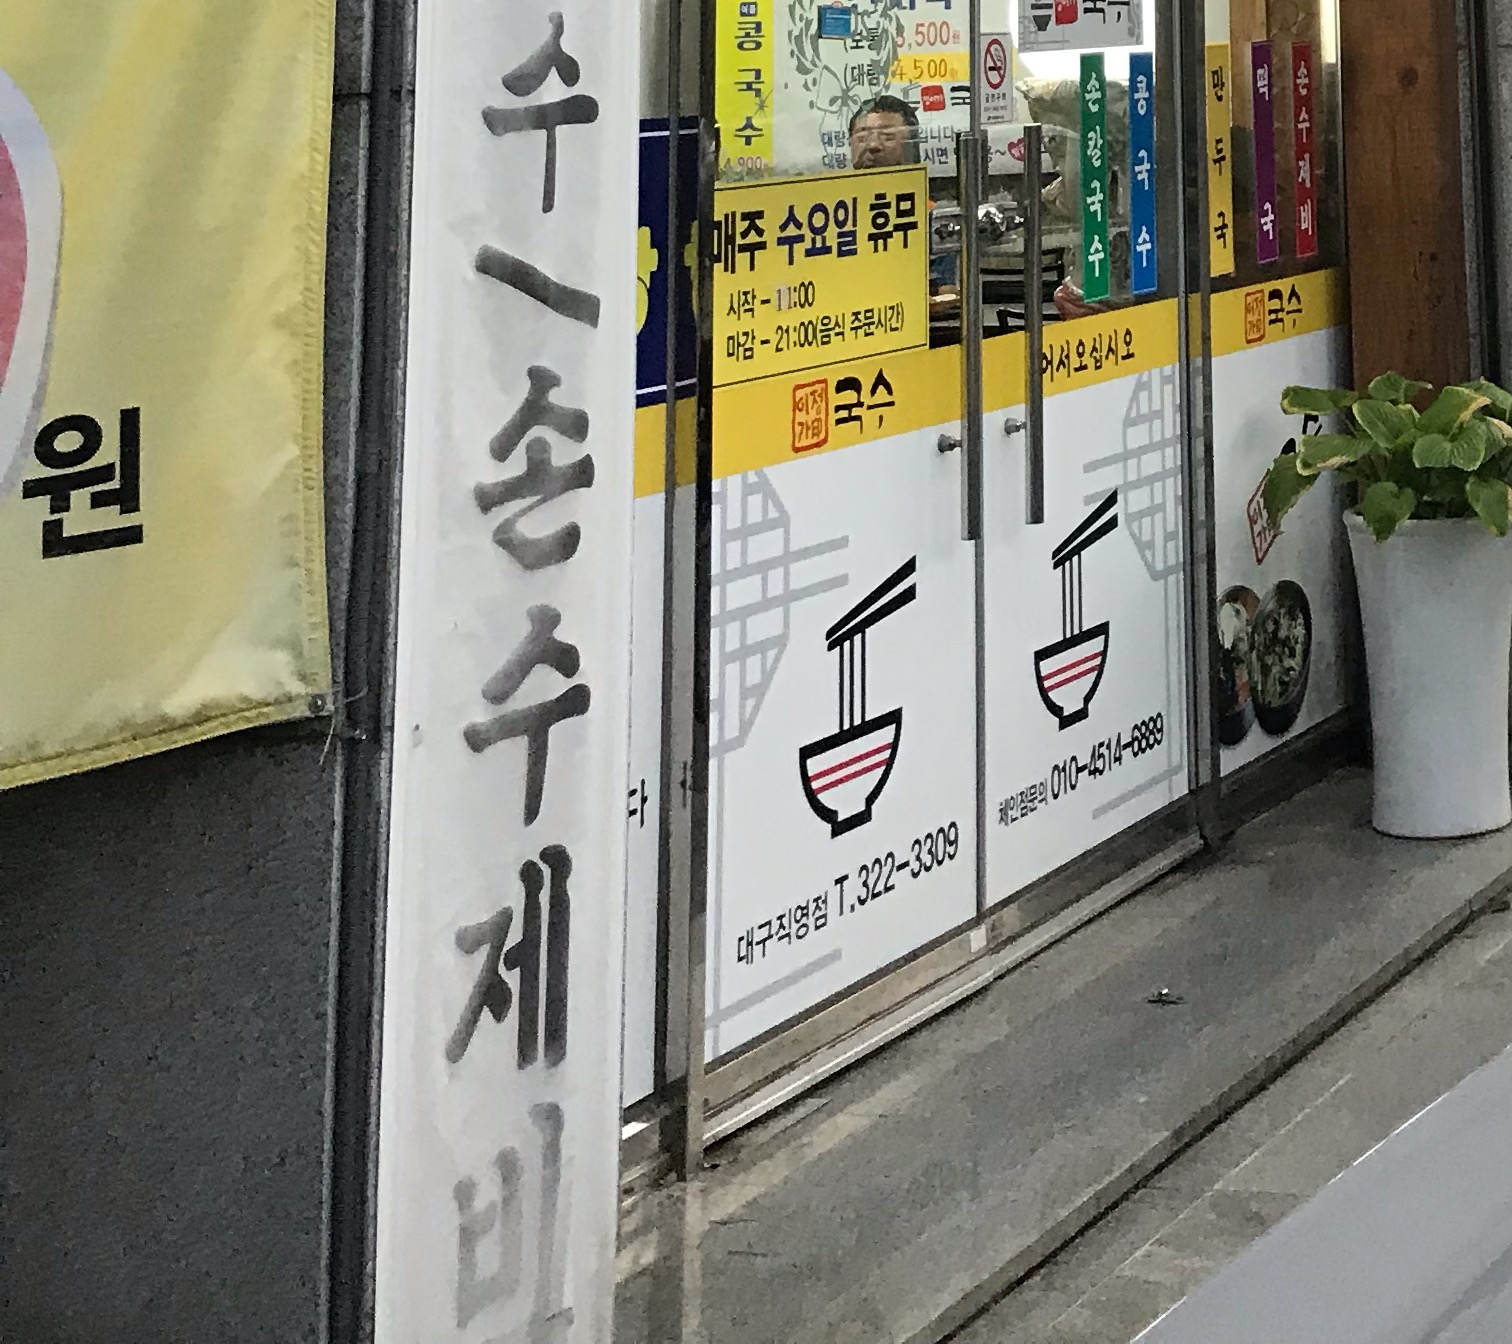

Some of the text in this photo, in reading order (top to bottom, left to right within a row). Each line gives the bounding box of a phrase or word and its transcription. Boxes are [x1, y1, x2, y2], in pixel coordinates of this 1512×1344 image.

[734, 21, 765, 146] 콩국수
[1084, 70, 1106, 279] 손칼국수
[1211, 65, 1228, 249] 만두국
[1256, 62, 1275, 241] 떡국
[1296, 60, 1312, 236] 손수제비
[713, 191, 919, 275] 매주 수요일 휴무
[727, 287, 756, 321] 시작
[775, 280, 816, 312] 11:00
[727, 328, 756, 362] 마감
[1042, 327, 1136, 383] 어서오십시오
[1267, 283, 1303, 333] 국수
[834, 367, 896, 434] 국수
[20, 404, 146, 559] 원
[998, 710, 1165, 828] 체인점문의 010-4514-6889
[736, 820, 960, 967] 대구직영점 T.322-3309
